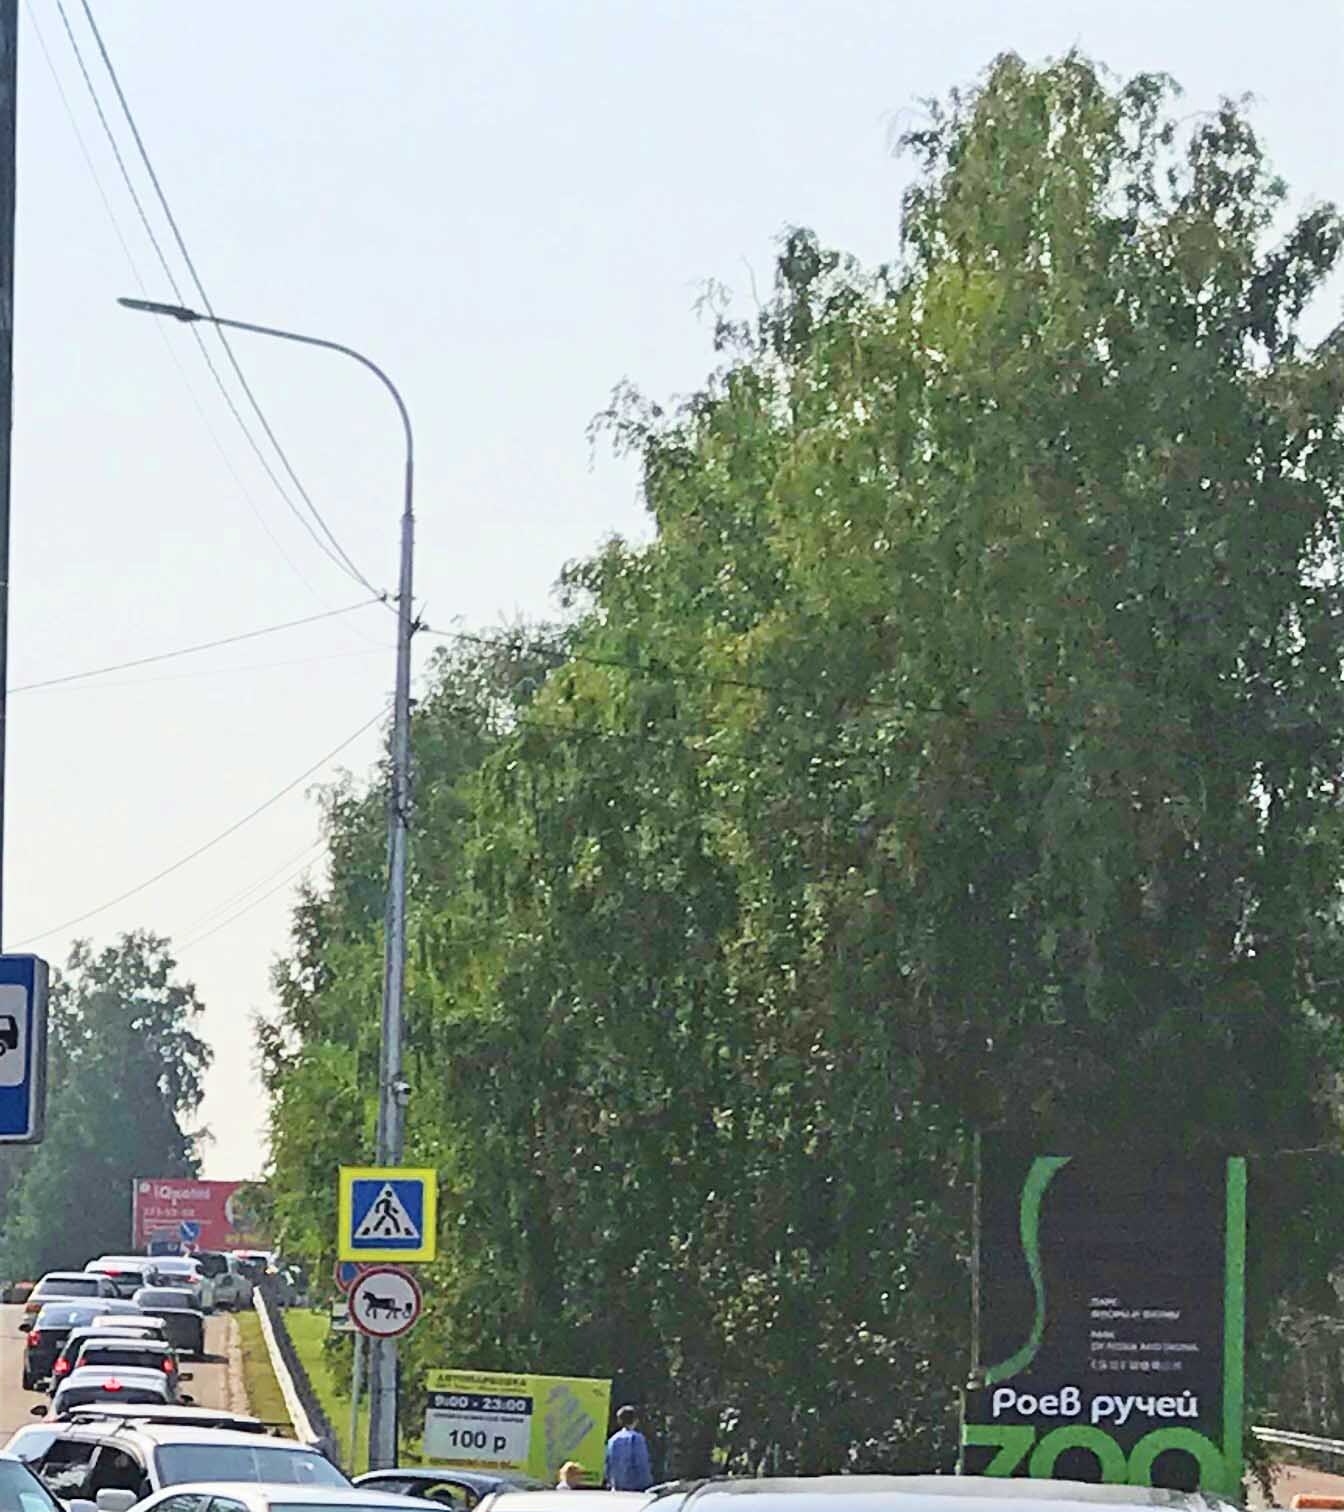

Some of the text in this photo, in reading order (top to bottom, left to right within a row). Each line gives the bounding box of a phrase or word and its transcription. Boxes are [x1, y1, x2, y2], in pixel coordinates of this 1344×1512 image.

[482, 1397, 526, 1411] 23:00
[992, 1386, 1199, 1425] Роев ручей
[449, 1430, 487, 1449] 100
